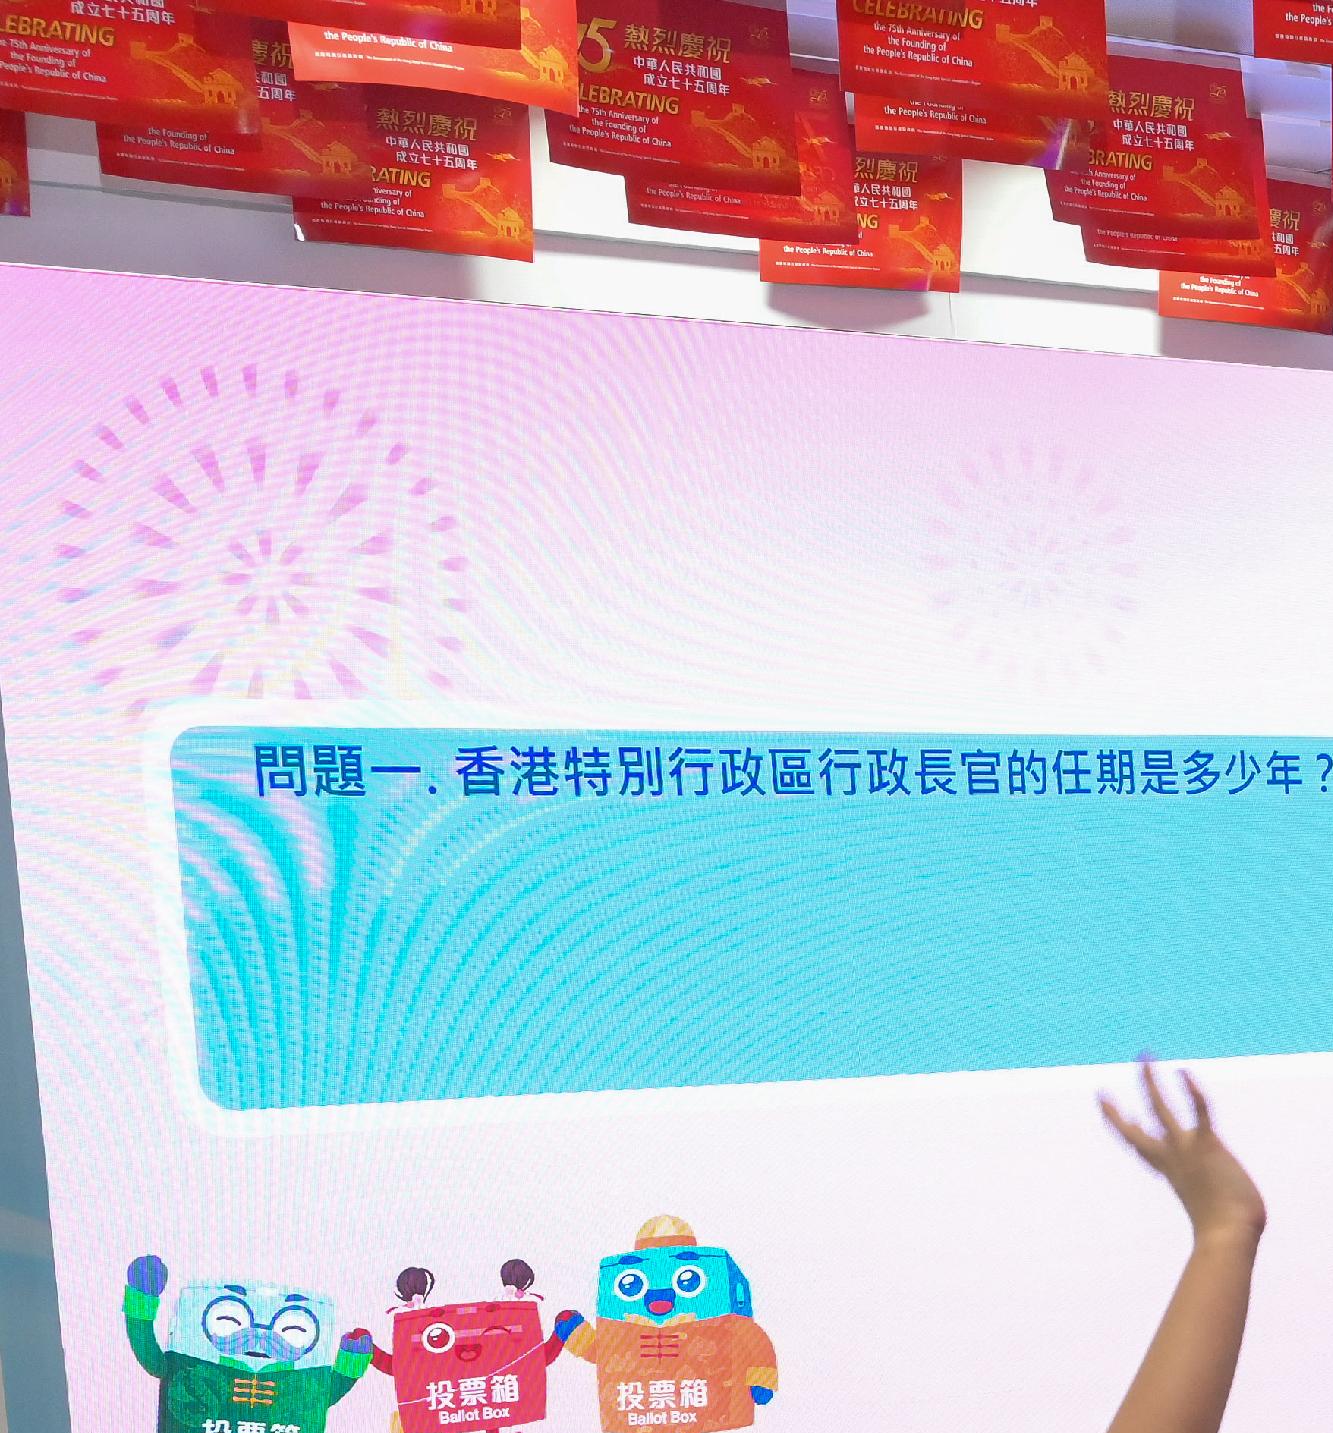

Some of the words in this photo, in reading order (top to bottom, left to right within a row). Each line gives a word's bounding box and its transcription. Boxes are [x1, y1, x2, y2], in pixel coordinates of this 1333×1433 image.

[71, 1, 175, 25] 成立七十五周年
[874, 22, 886, 32] the
[888, 24, 904, 34] 75th
[907, 26, 950, 41] Anniversary
[953, 32, 960, 41] of
[31, 41, 79, 58] Anniversary
[82, 49, 91, 57] of
[324, 31, 339, 40] the
[341, 32, 378, 44] People's
[380, 35, 416, 48] Republic
[418, 39, 427, 49] of
[430, 40, 453, 53] China
[624, 23, 731, 64] 熱烈慶祝
[888, 36, 900, 46] the
[902, 37, 936, 52] Founding
[938, 42, 946, 51] of
[11, 52, 24, 60] the
[27, 54, 65, 67] Founding
[70, 59, 76, 67] of
[863, 45, 875, 54] the
[876, 46, 906, 59] People's
[908, 51, 939, 63] Republic
[942, 55, 950, 64] of
[951, 56, 973, 68] China
[34, 66, 69, 78] Republic
[72, 71, 81, 80] of
[83, 72, 107, 83] China
[633, 56, 721, 80] 中華人民共和國
[643, 74, 730, 96] 成立七十五周年
[579, 83, 679, 115] LEBRATING
[1108, 90, 1195, 121] 熱烈慶祝
[376, 108, 478, 141] 熱烈慶祝
[592, 118, 603, 126] the
[605, 120, 636, 133] Founding
[639, 125, 646, 133] of
[609, 110, 649, 124] Anniversary
[884, 106, 896, 116] the
[898, 107, 928, 119] People's
[930, 110, 959, 122] Republic
[961, 114, 967, 122] of
[969, 115, 987, 125] China
[583, 127, 609, 138] People's
[612, 131, 640, 143] Republic
[652, 138, 672, 147] China
[1113, 119, 1187, 137] 中華人民共和國
[385, 136, 469, 156] 中華人民共和國
[1122, 134, 1194, 151] 成立七十五周年
[396, 152, 478, 170] 成立七十五周年
[321, 202, 333, 210] the
[335, 203, 363, 212] People's
[366, 205, 395, 216] Republic
[397, 208, 404, 216] of
[406, 209, 425, 218] China
[426, 1373, 519, 1410] 投票箱
[616, 1379, 708, 1411] 投票箱
[439, 1407, 480, 1425] Ballot
[482, 1405, 511, 1420] Box
[628, 1411, 667, 1426] Ballot
[670, 1410, 697, 1425] Box
